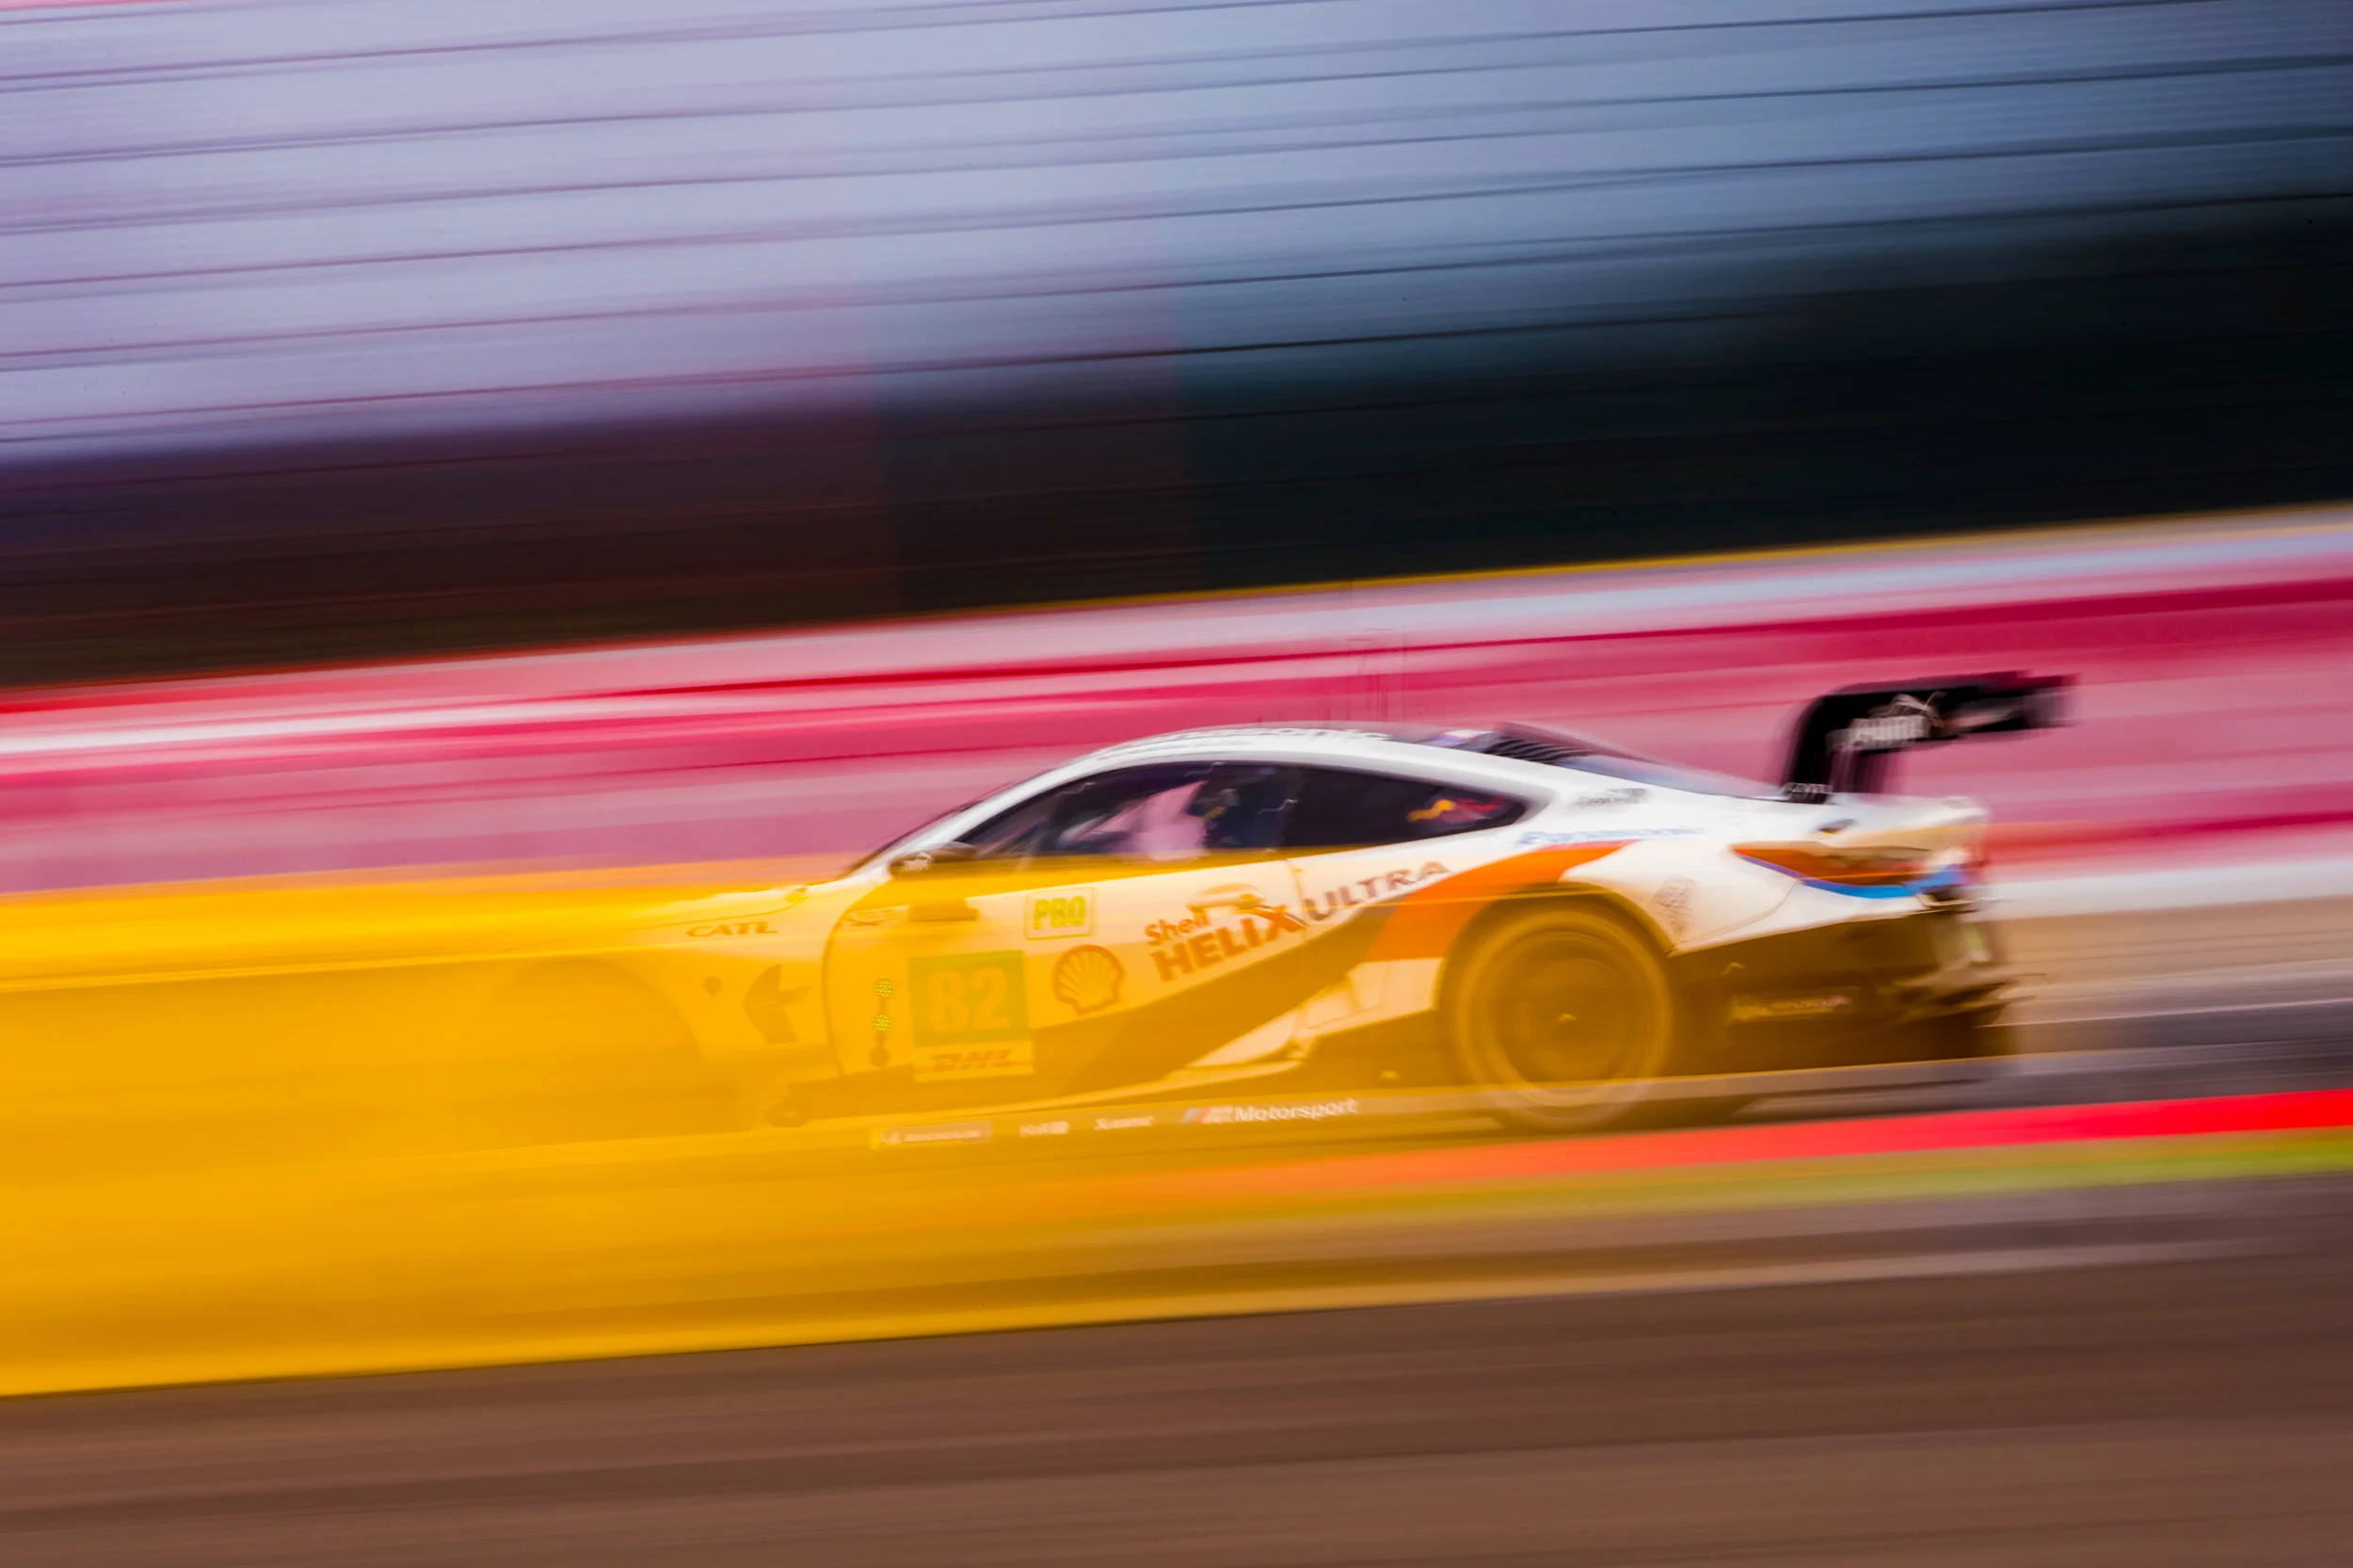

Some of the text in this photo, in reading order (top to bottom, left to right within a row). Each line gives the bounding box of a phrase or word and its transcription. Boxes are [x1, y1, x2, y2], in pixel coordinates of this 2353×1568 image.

[685, 919, 779, 938] CATL
[1032, 895, 1086, 931] PRO
[1144, 905, 1211, 947] Shell
[1149, 860, 1455, 983] HELIX ULTRA
[927, 967, 1013, 1034] 82
[930, 1048, 1016, 1073] DHL
[1235, 1096, 1361, 1122] Motorsport
